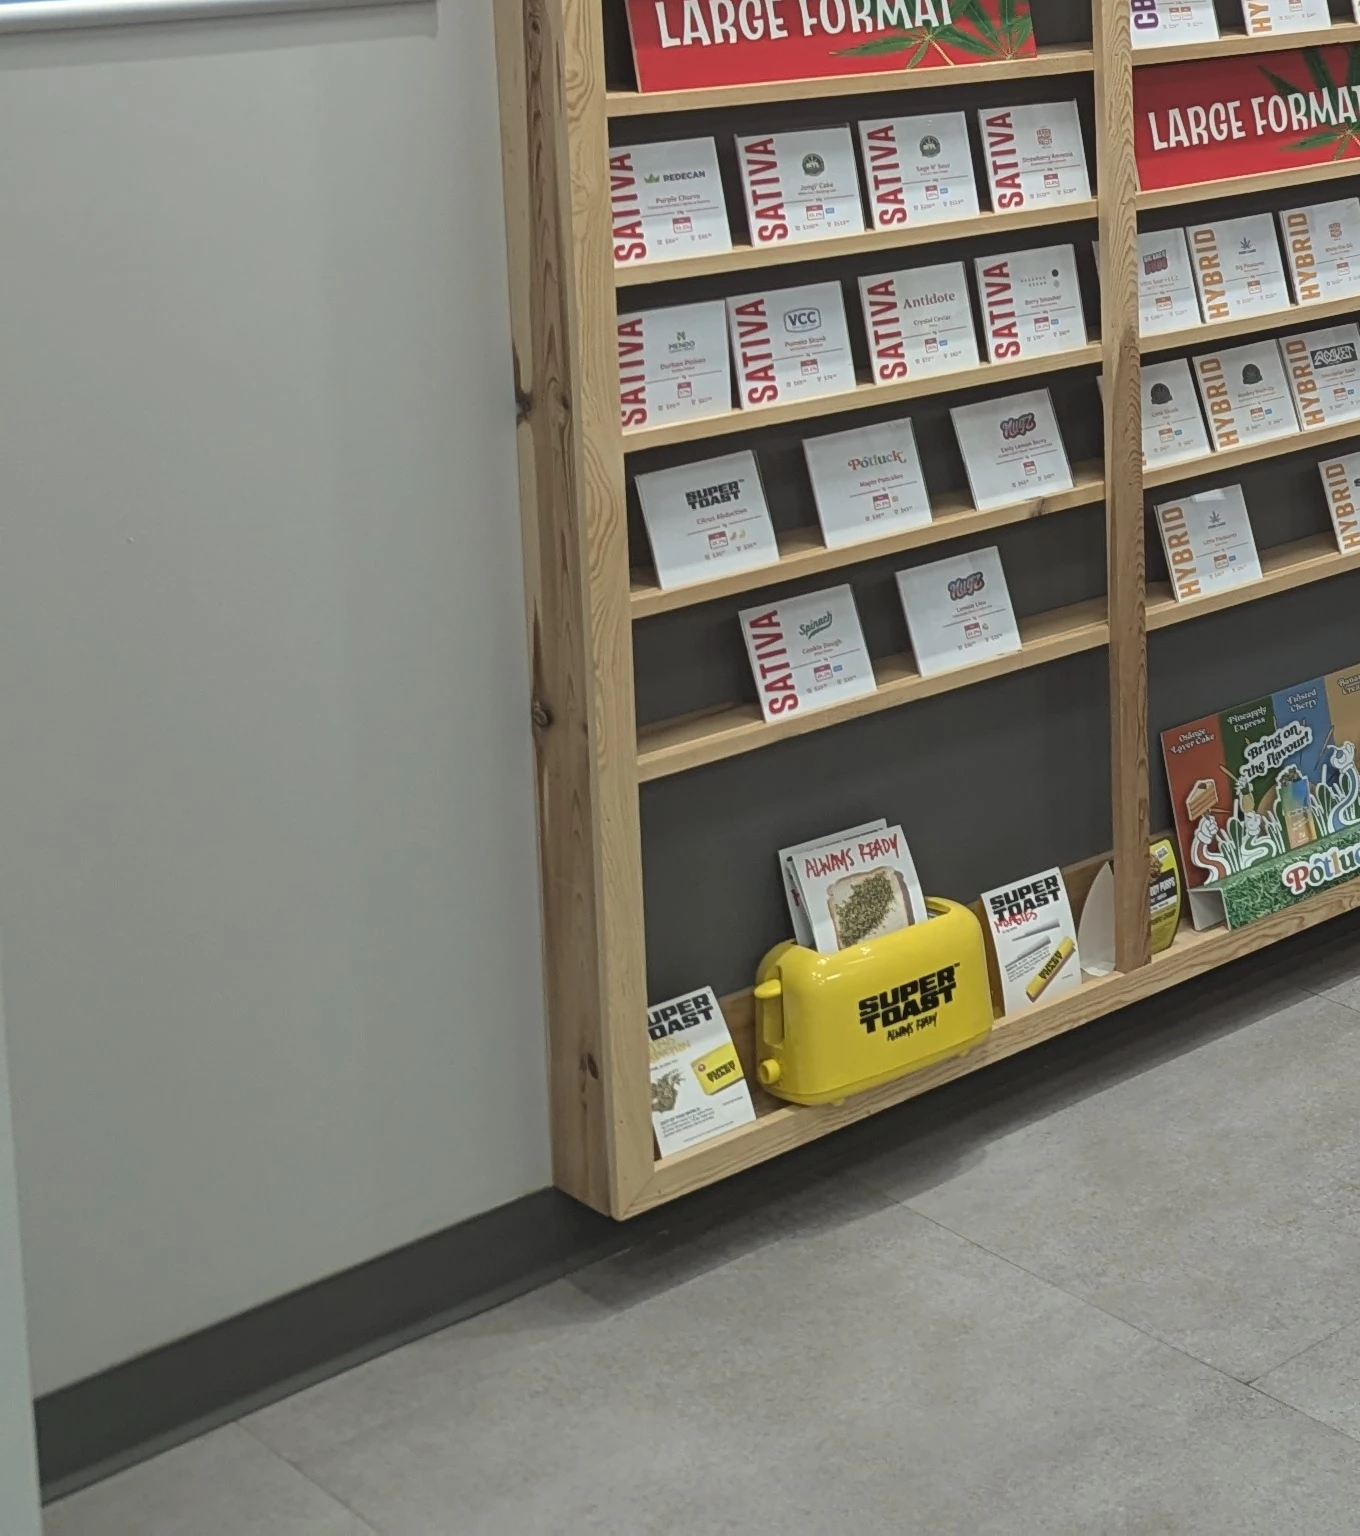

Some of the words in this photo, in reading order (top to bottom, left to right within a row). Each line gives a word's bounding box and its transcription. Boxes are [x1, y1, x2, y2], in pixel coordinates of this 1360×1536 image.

[1148, 100, 1246, 151] LARGE
[903, 290, 956, 310] Antidote
[788, 311, 817, 328] VCC
[798, 610, 834, 640] Spinach
[748, 610, 798, 716] SATIVA
[1233, 716, 1266, 733] Express
[1247, 735, 1282, 760] Bring
[1283, 724, 1301, 739] on
[1243, 760, 1266, 778] the
[1266, 731, 1310, 766] flavour!
[803, 848, 856, 879] ALWAYS
[858, 833, 900, 862] READY
[989, 874, 1060, 909] SUPER
[991, 887, 1061, 923] TOAST
[858, 963, 957, 1017] SUPER
[859, 982, 957, 1035] TOAST
